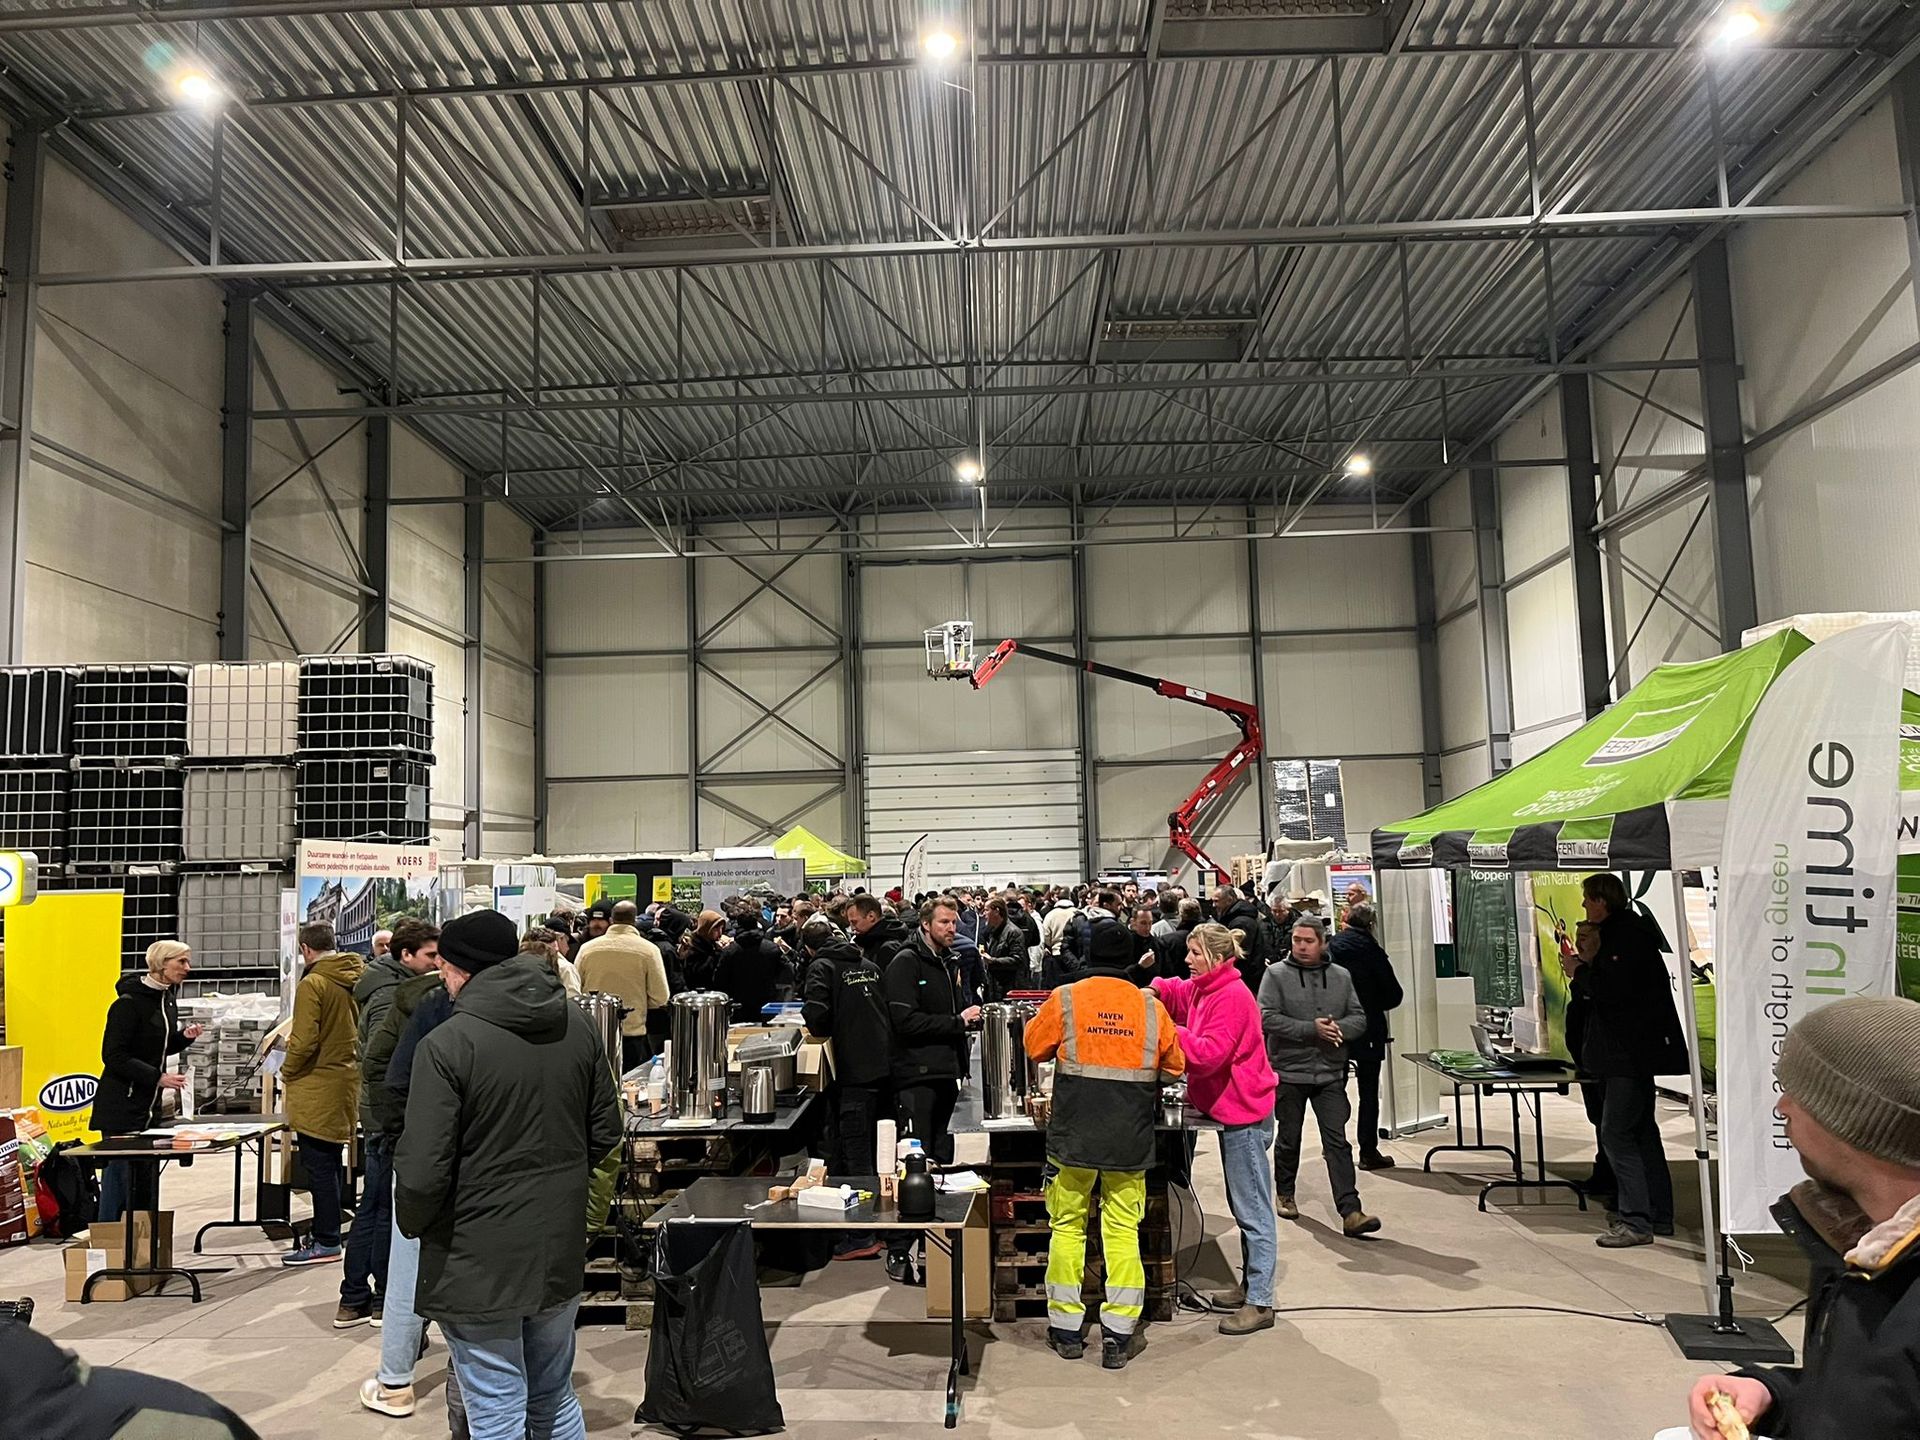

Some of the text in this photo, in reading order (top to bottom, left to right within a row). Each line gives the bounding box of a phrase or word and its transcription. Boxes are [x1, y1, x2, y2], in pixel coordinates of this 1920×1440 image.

[307, 850, 331, 859] Duurzame
[1558, 842, 1577, 856] FERT
[1586, 842, 1608, 856] TIME
[307, 862, 326, 870] Sentiers
[396, 856, 423, 866] KOERS
[707, 869, 734, 877] stabiele
[734, 868, 775, 877] ondergrond
[1533, 872, 1581, 887] with Nature
[1507, 917, 1518, 1001] with Nature
[1097, 1012, 1124, 1021] HAVEN
[1087, 1026, 1134, 1037] ANTWERPEN
[48, 1080, 95, 1105] VIANO
[48, 1115, 77, 1128] Naturally
